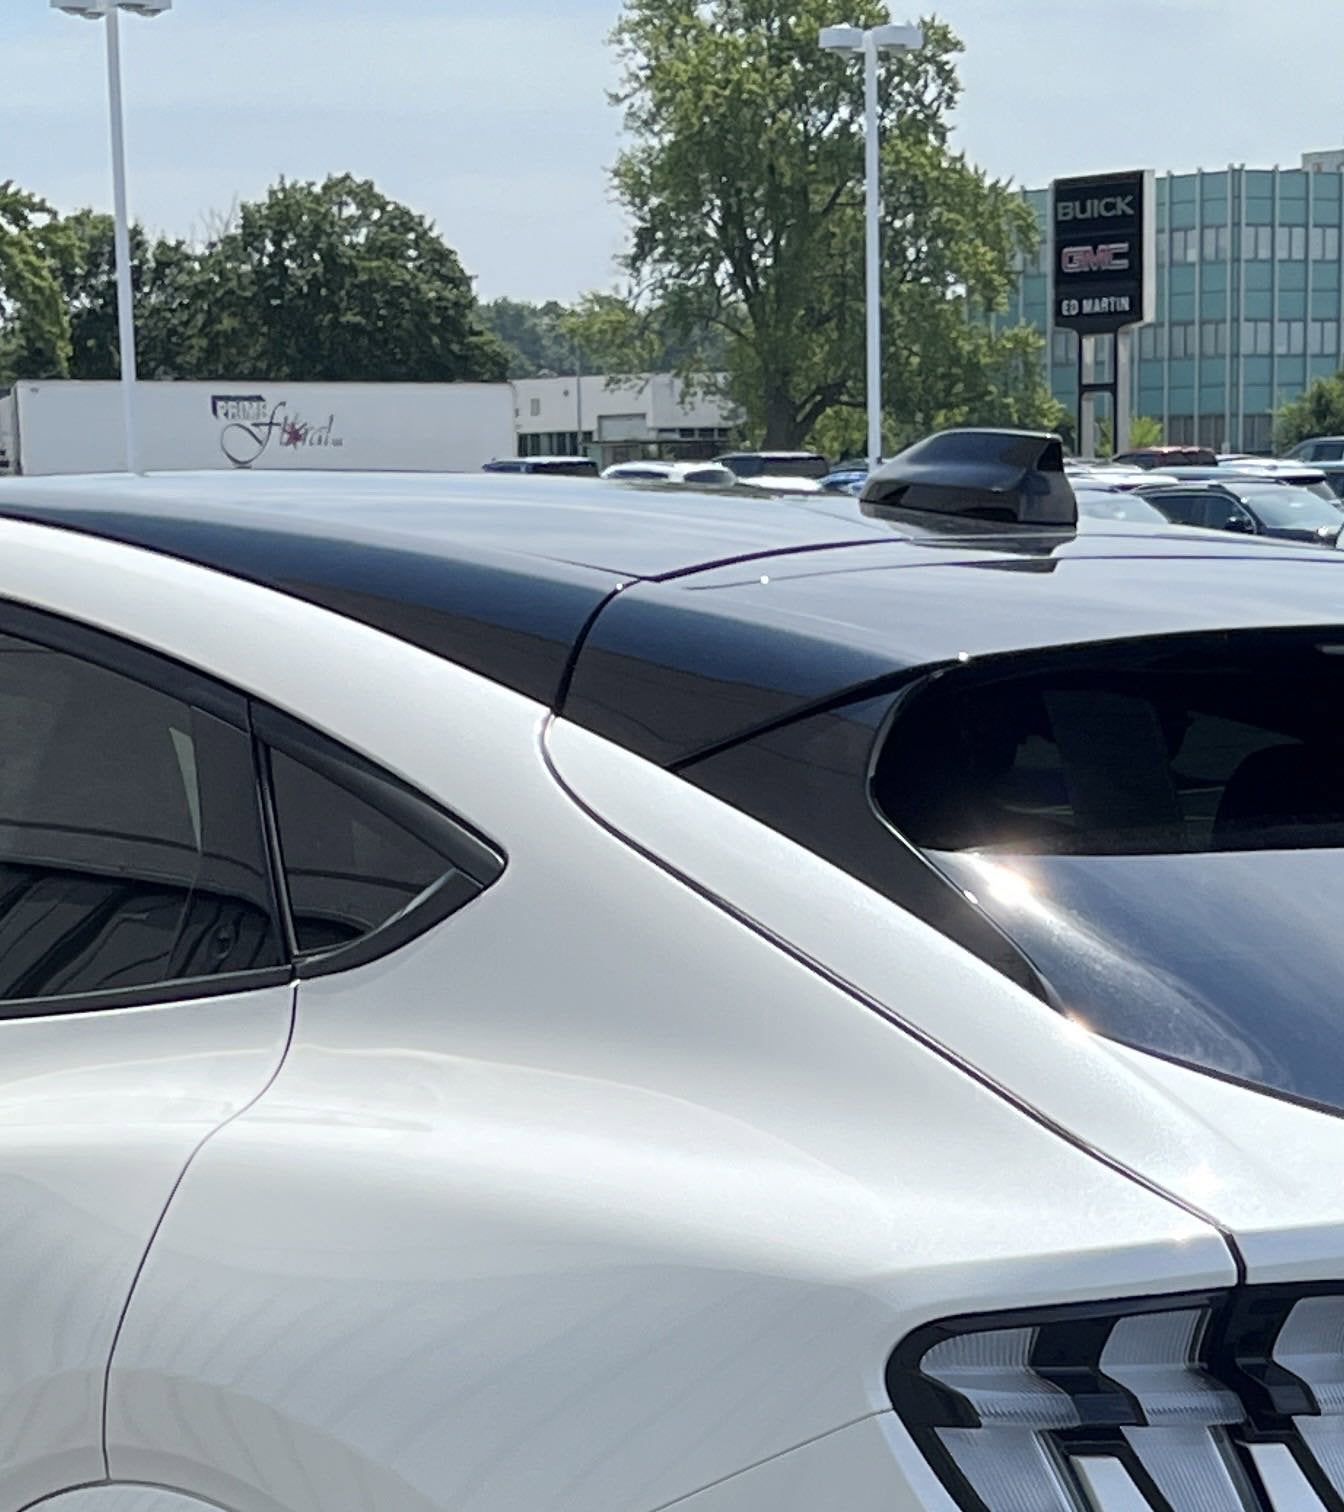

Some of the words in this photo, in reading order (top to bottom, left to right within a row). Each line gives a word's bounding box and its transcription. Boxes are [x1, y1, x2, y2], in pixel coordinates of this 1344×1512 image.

[1057, 195, 1135, 221] BUICK
[1061, 242, 1130, 273] GMC
[1061, 299, 1080, 316] ED
[1082, 296, 1131, 315] MARTIN
